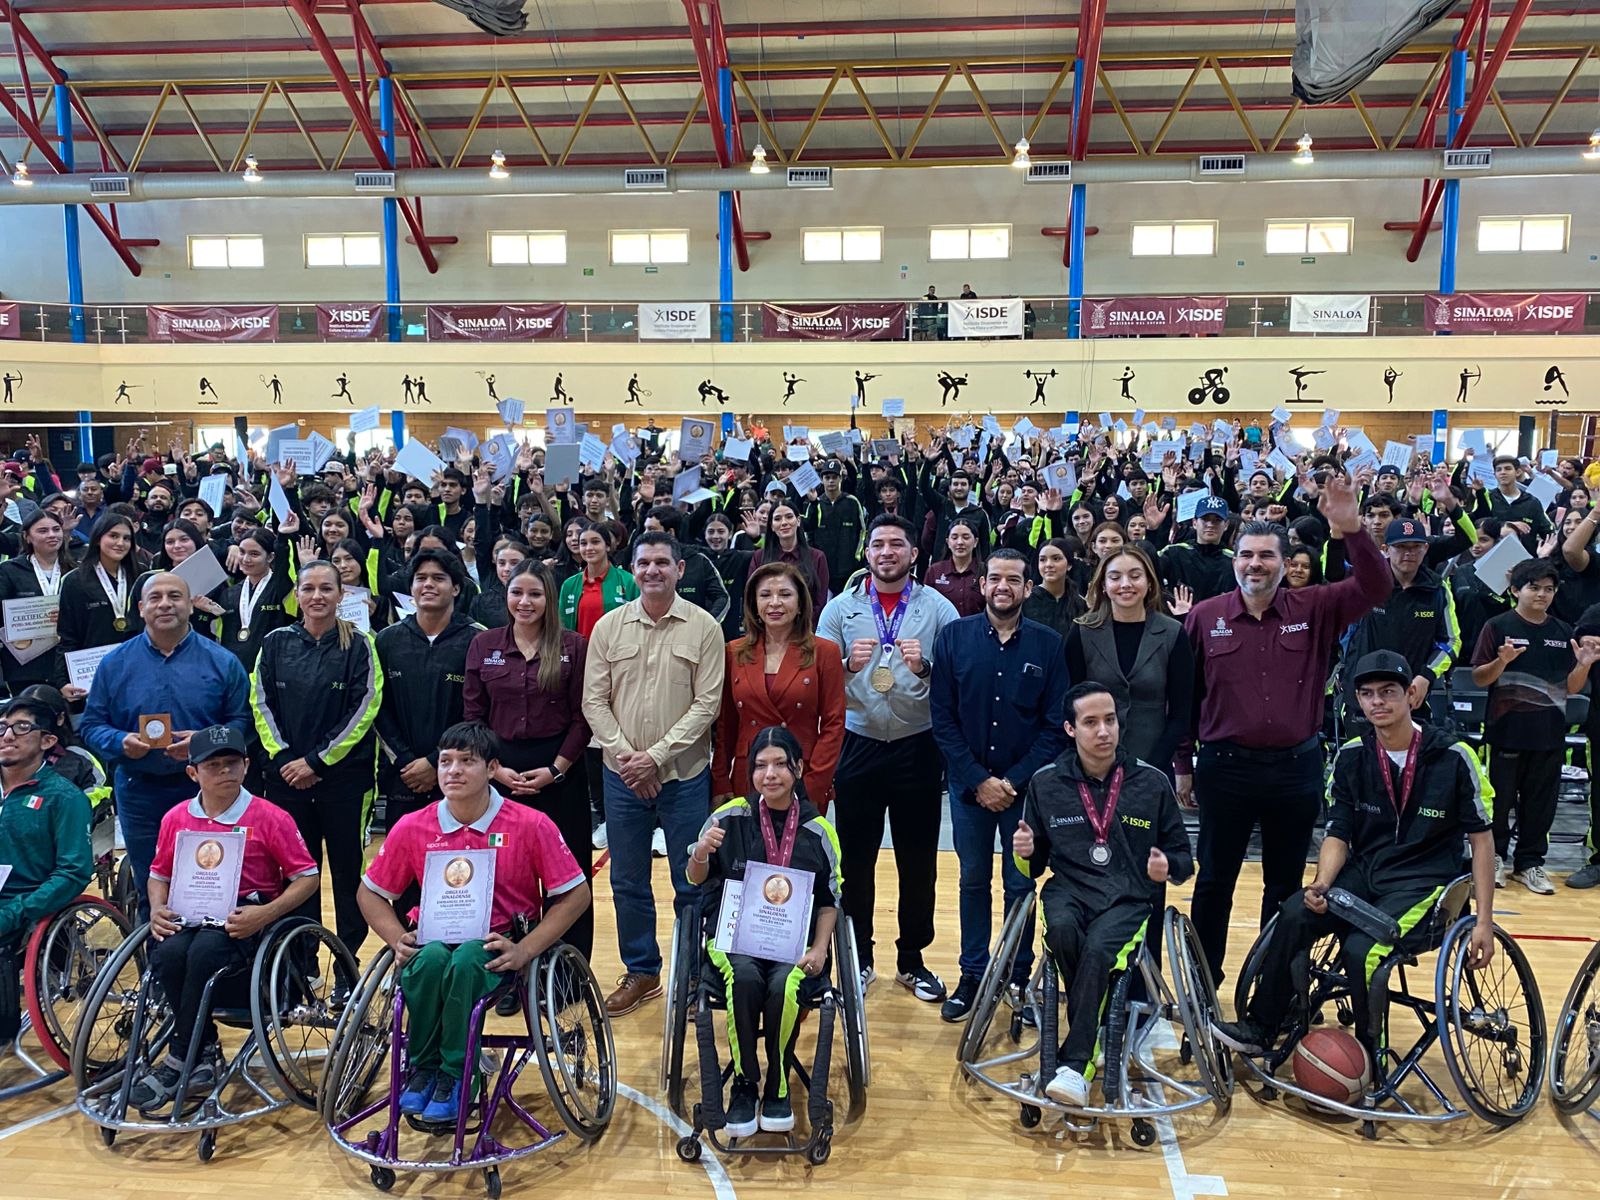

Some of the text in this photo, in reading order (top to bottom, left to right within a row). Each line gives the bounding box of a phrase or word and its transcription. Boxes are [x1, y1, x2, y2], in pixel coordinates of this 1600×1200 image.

[340, 311, 370, 322] ISDE
[665, 310, 696, 321] ISDE
[976, 307, 1008, 318] ISDE
[1109, 311, 1166, 321] SINALOA
[1189, 309, 1223, 321] ISDE
[1313, 310, 1362, 319] SINALOA
[1453, 307, 1514, 318] SINALOA
[1538, 305, 1575, 318] ISDE
[172, 319, 221, 328] SINALOA
[241, 316, 270, 329] ISDE
[458, 318, 506, 328] SINALOA
[526, 318, 553, 328] ISDE
[792, 317, 842, 327] SINALOA
[862, 317, 890, 328] ISDE
[12, 613, 49, 622] CERTIFICA
[1288, 622, 1309, 633] ISDE
[453, 674, 465, 682] ISD
[1423, 807, 1446, 819] ISDE
[1056, 815, 1085, 824] SINALOA
[1130, 817, 1152, 829] ISDE
